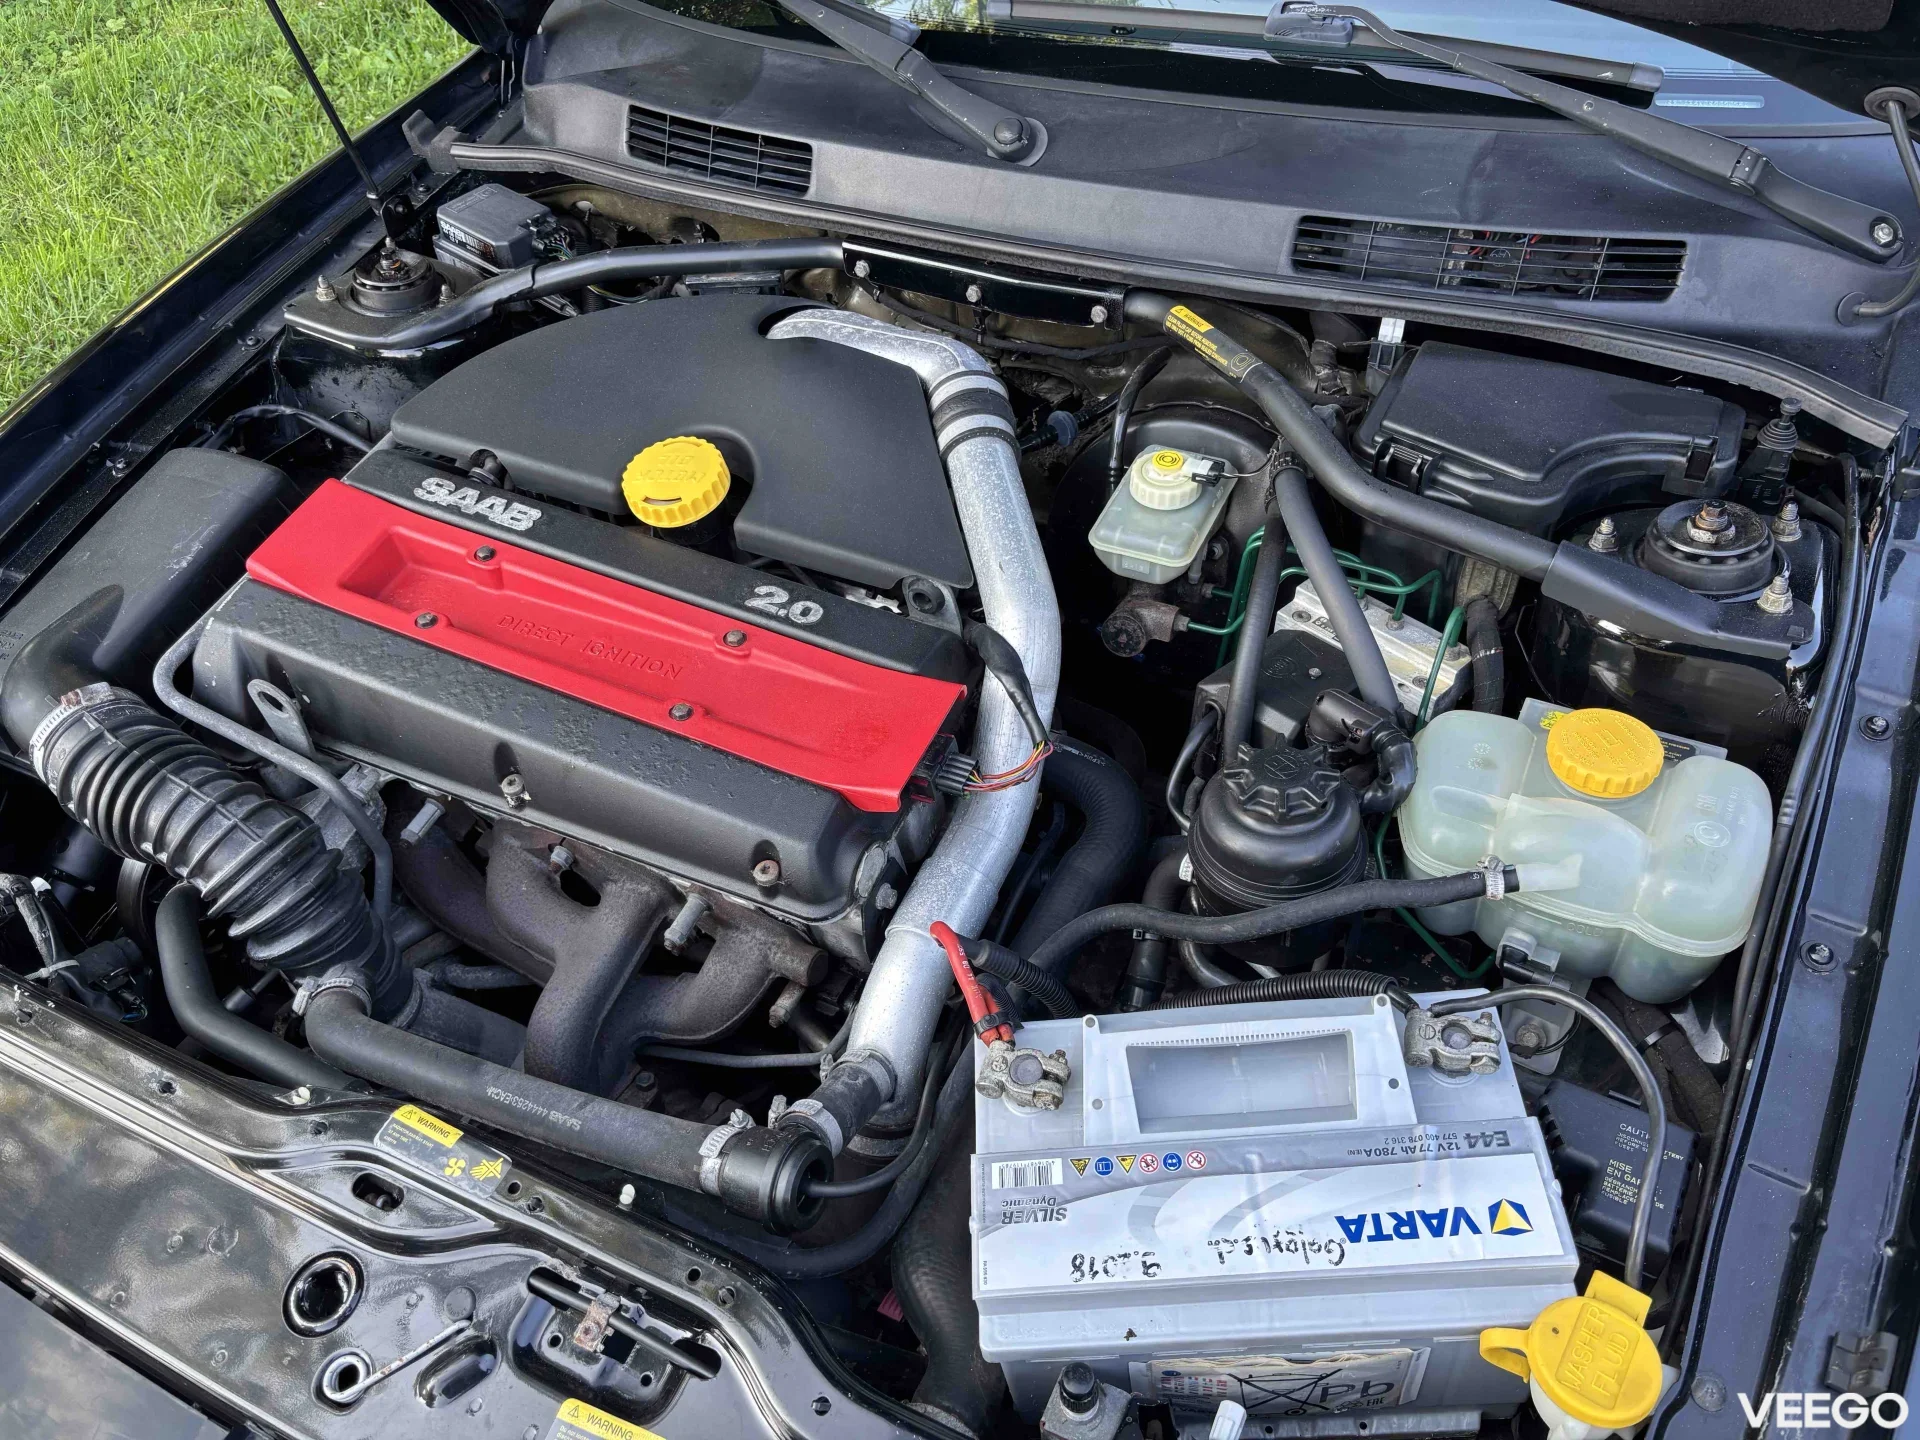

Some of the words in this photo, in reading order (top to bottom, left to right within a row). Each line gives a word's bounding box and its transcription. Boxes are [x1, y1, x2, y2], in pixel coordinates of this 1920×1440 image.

[413, 477, 542, 531] SAAB
[744, 585, 823, 624] 2.0
[497, 615, 575, 646] DIRECT
[580, 639, 684, 680] IGNITION
[1567, 922, 1603, 937] COLD
[416, 1116, 451, 1139] WARNING
[549, 1110, 582, 1131] SAAB
[1408, 1134, 1423, 1143] 078
[1425, 1133, 1440, 1142] 400
[1442, 1132, 1458, 1140] 577
[1463, 1130, 1511, 1149] E44
[1620, 1123, 1650, 1139] CAUTI
[1384, 1137, 1389, 1145] 2
[1392, 1136, 1407, 1145] 316
[1438, 1141, 1461, 1152] 12V
[1606, 1166, 1621, 1178] EN
[1609, 1159, 1632, 1174] MISE
[1002, 1195, 1057, 1209] Dynamic
[1002, 1207, 1067, 1225] SILVER
[1334, 1206, 1483, 1244] VARTA
[1560, 1306, 1605, 1391] WASHER
[1591, 1332, 1630, 1397] FLUID
[1319, 1380, 1395, 1403] Pb
[586, 1412, 634, 1440] WARNING
